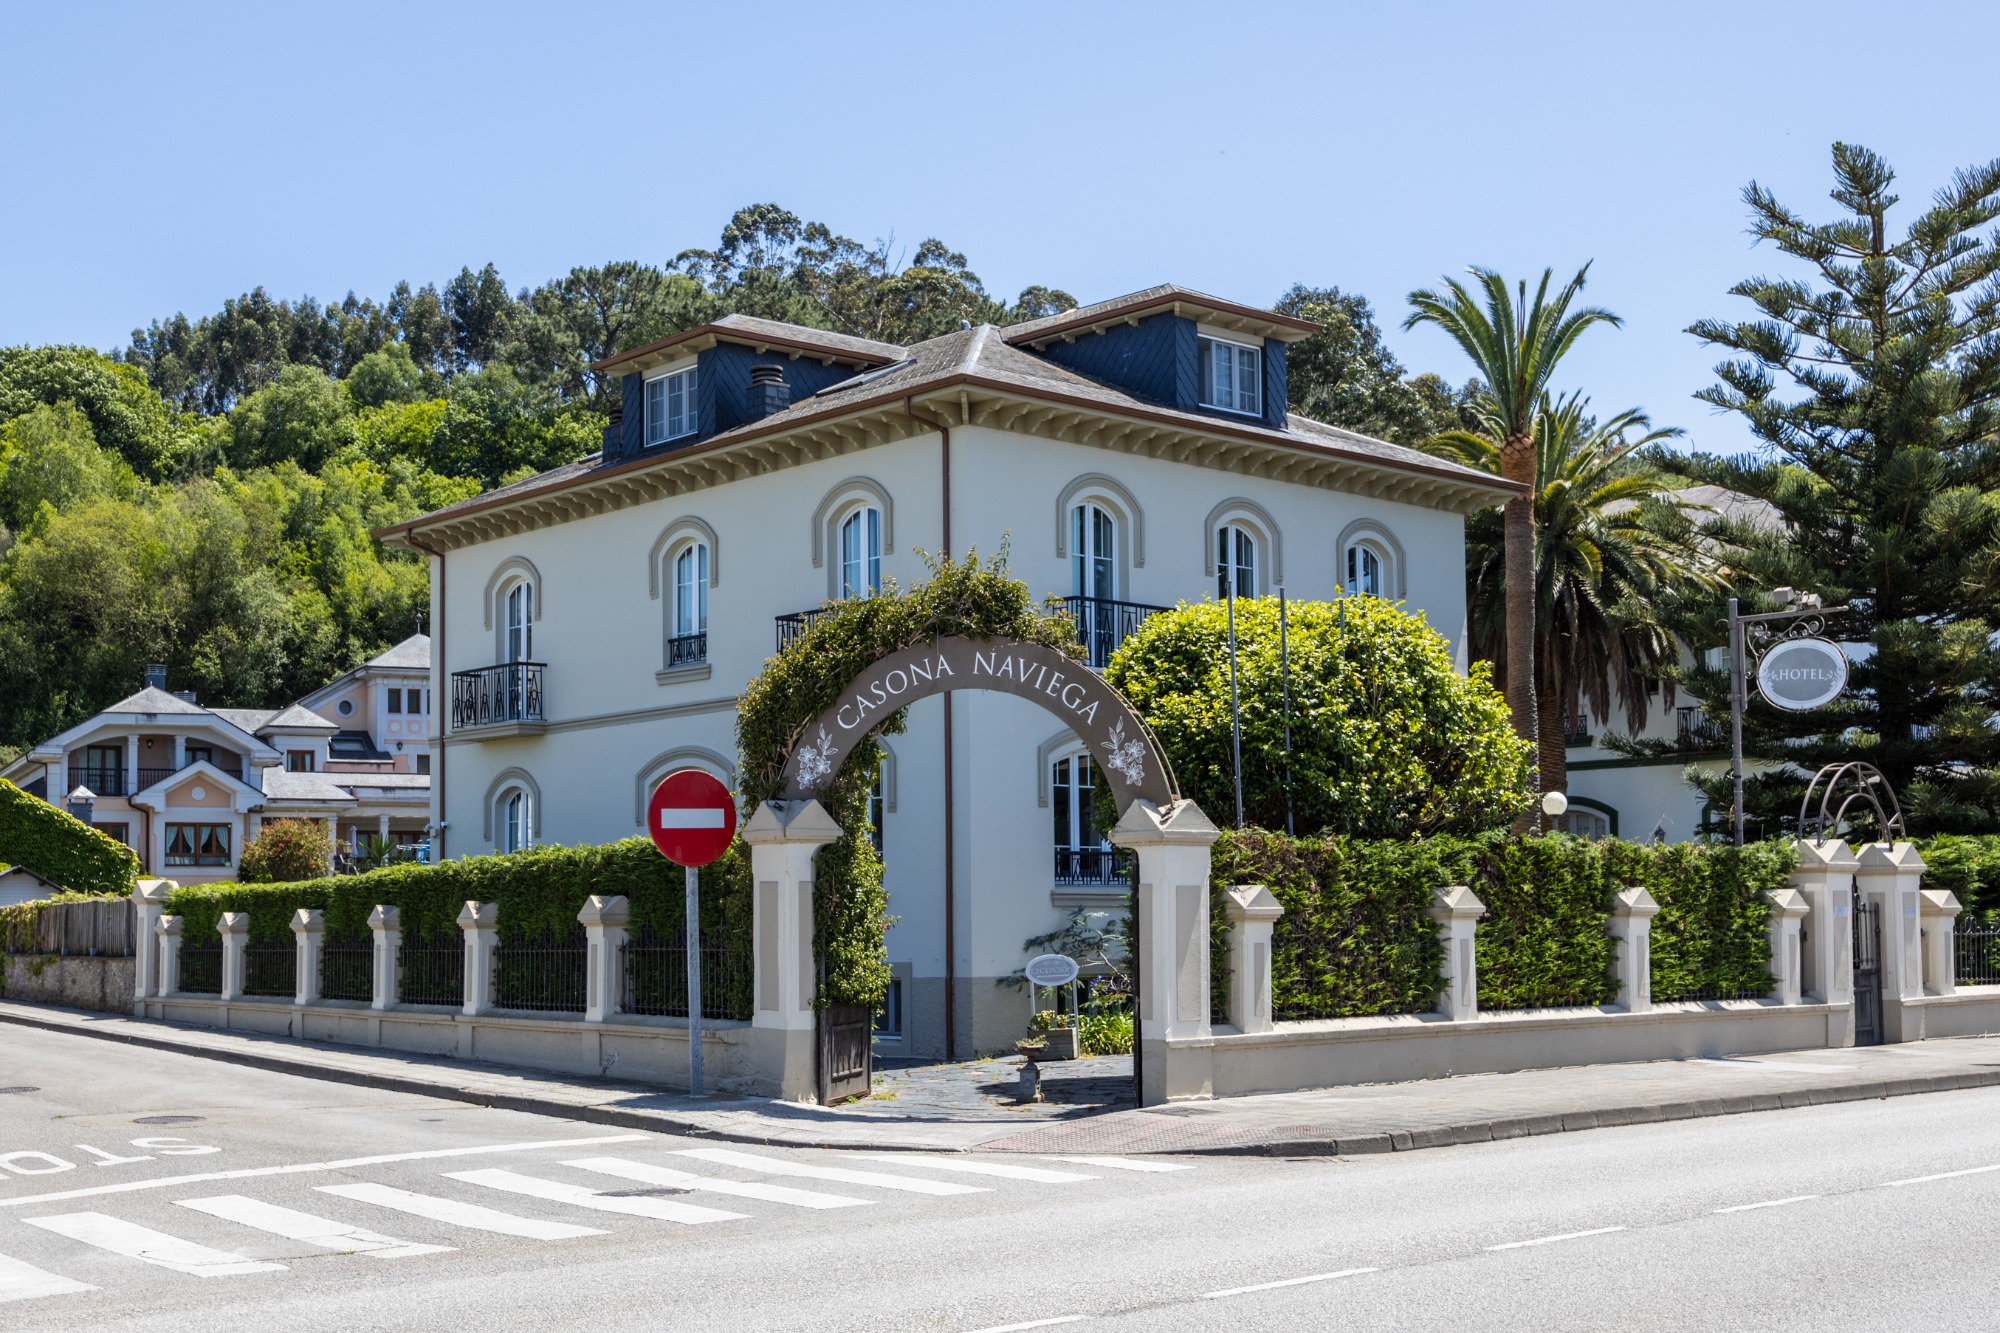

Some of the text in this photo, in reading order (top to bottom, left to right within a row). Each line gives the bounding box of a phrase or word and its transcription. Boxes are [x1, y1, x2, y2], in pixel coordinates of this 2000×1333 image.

[837, 651, 1099, 730] CASONA NAVIEGA
[1779, 668, 1825, 680] HOTEL
[0, 1137, 222, 1180] STO
